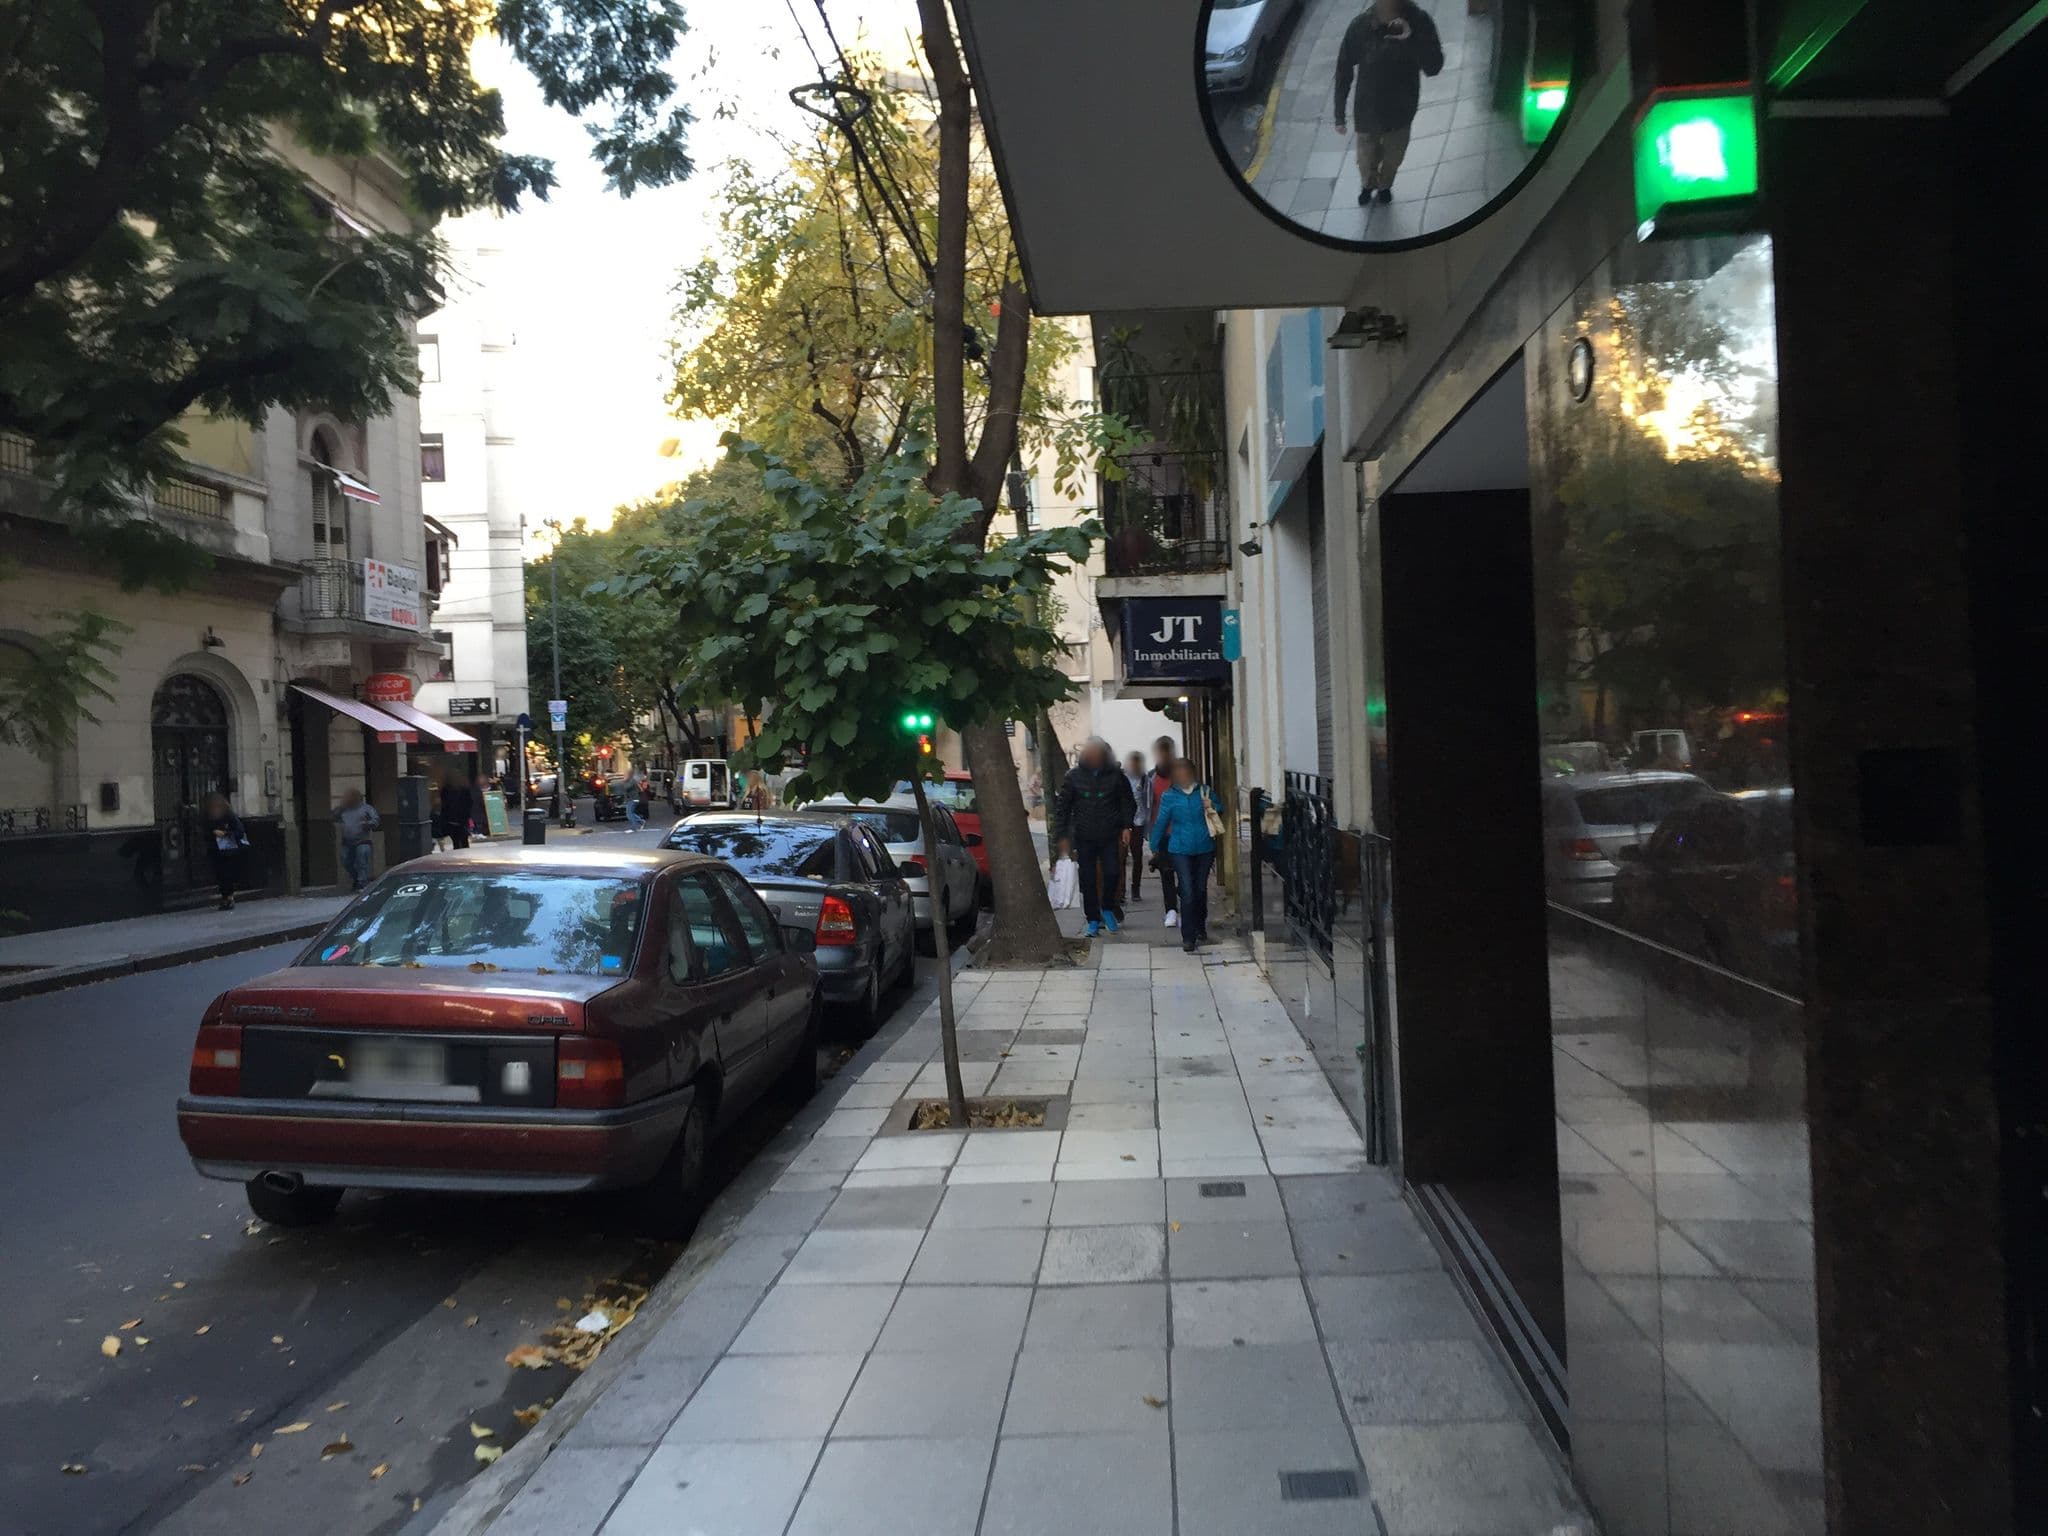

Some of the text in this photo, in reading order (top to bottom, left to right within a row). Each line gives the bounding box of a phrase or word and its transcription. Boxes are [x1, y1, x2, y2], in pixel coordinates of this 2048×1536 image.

[1150, 615, 1202, 643] JT
[1134, 649, 1220, 661] Inmobiliaria
[528, 1014, 575, 1026] OPEL
